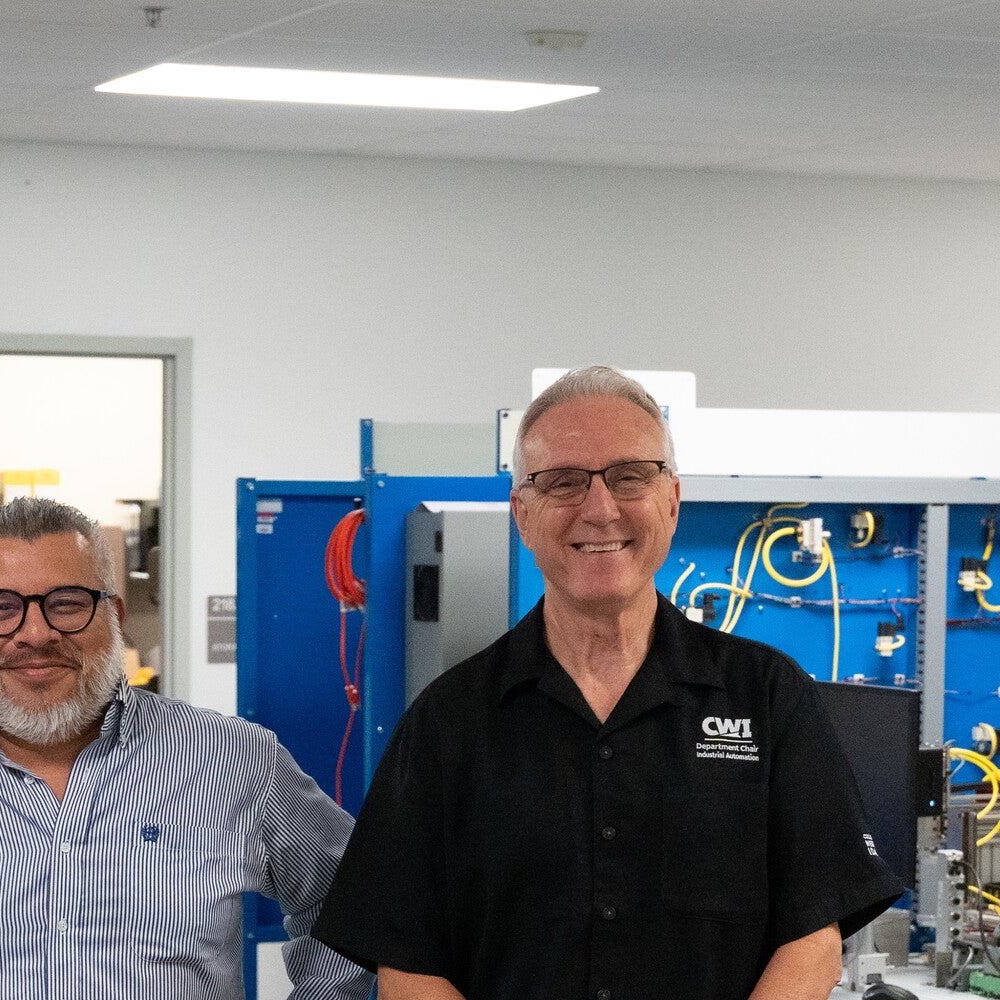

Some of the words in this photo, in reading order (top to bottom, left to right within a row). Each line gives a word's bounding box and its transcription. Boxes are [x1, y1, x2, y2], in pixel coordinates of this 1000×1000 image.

[701, 716, 753, 738] CWI
[696, 742, 740, 752] Department
[740, 744, 759, 753] Chair
[696, 751, 725, 759] Industrial
[725, 752, 760, 762] Automation
